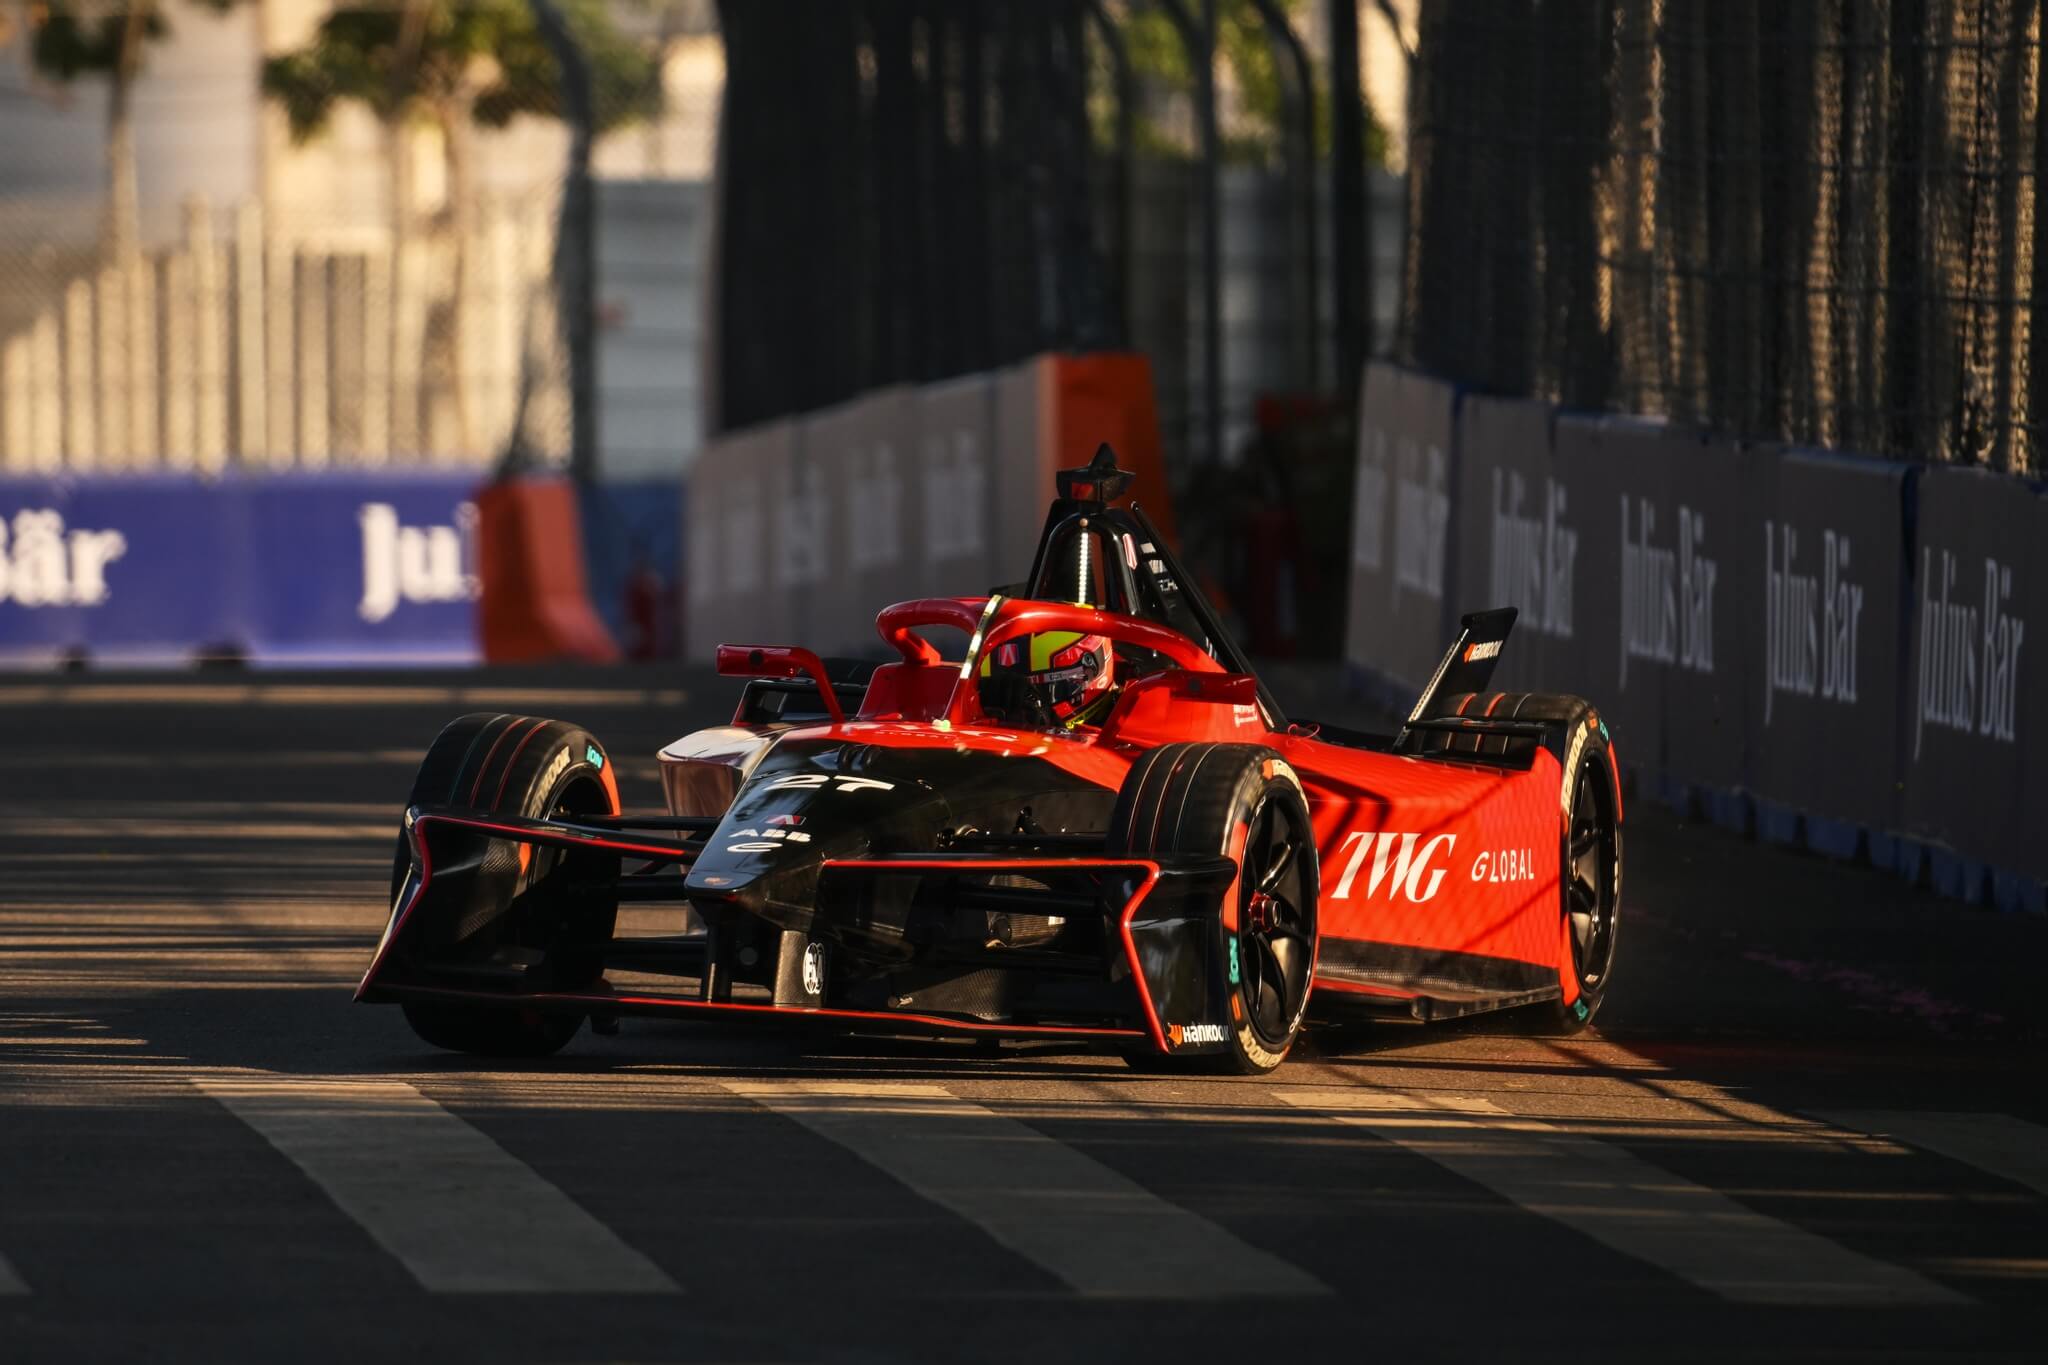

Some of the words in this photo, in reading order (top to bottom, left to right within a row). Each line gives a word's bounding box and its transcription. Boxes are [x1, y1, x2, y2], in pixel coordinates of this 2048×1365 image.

[0, 508, 128, 607] är
[1764, 519, 1818, 727] Julius
[1822, 528, 1864, 703] Bär
[1912, 546, 1978, 762] Julius
[1979, 556, 2024, 742] Bär
[763, 774, 897, 793] 27
[728, 828, 812, 843] ABB
[1330, 830, 1458, 903] TWG
[1470, 848, 1536, 883] GLOBAL
